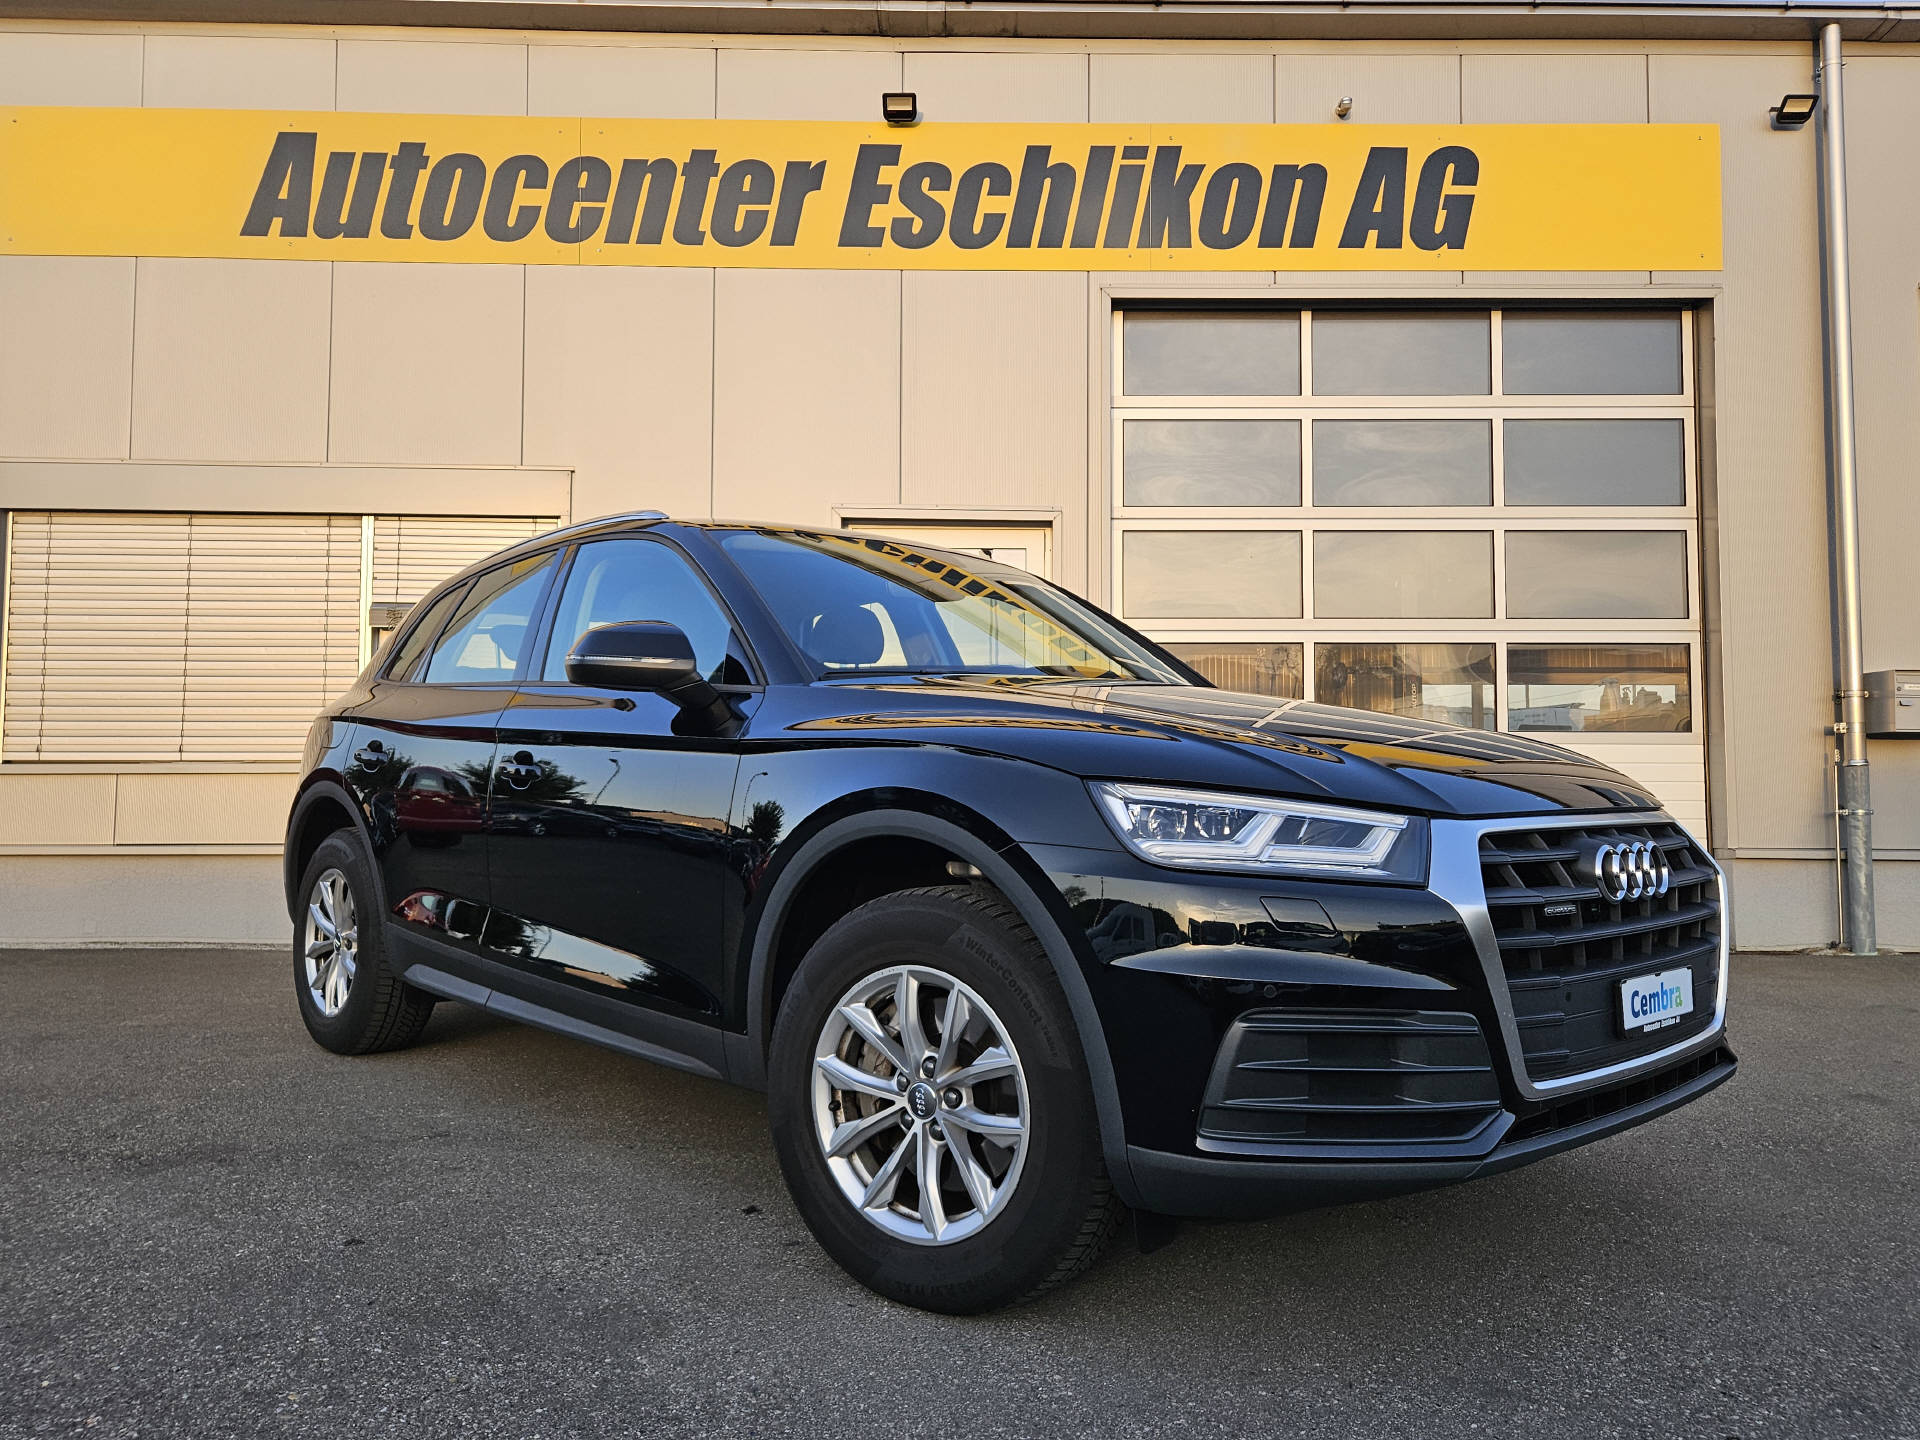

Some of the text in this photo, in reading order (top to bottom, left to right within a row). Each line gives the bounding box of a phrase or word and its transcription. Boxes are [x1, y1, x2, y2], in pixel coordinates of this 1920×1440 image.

[240, 131, 1480, 250] Autocenter Eschlikon AG
[965, 936, 1042, 1025] WinterContact
[1630, 981, 1683, 1018] Cembra
